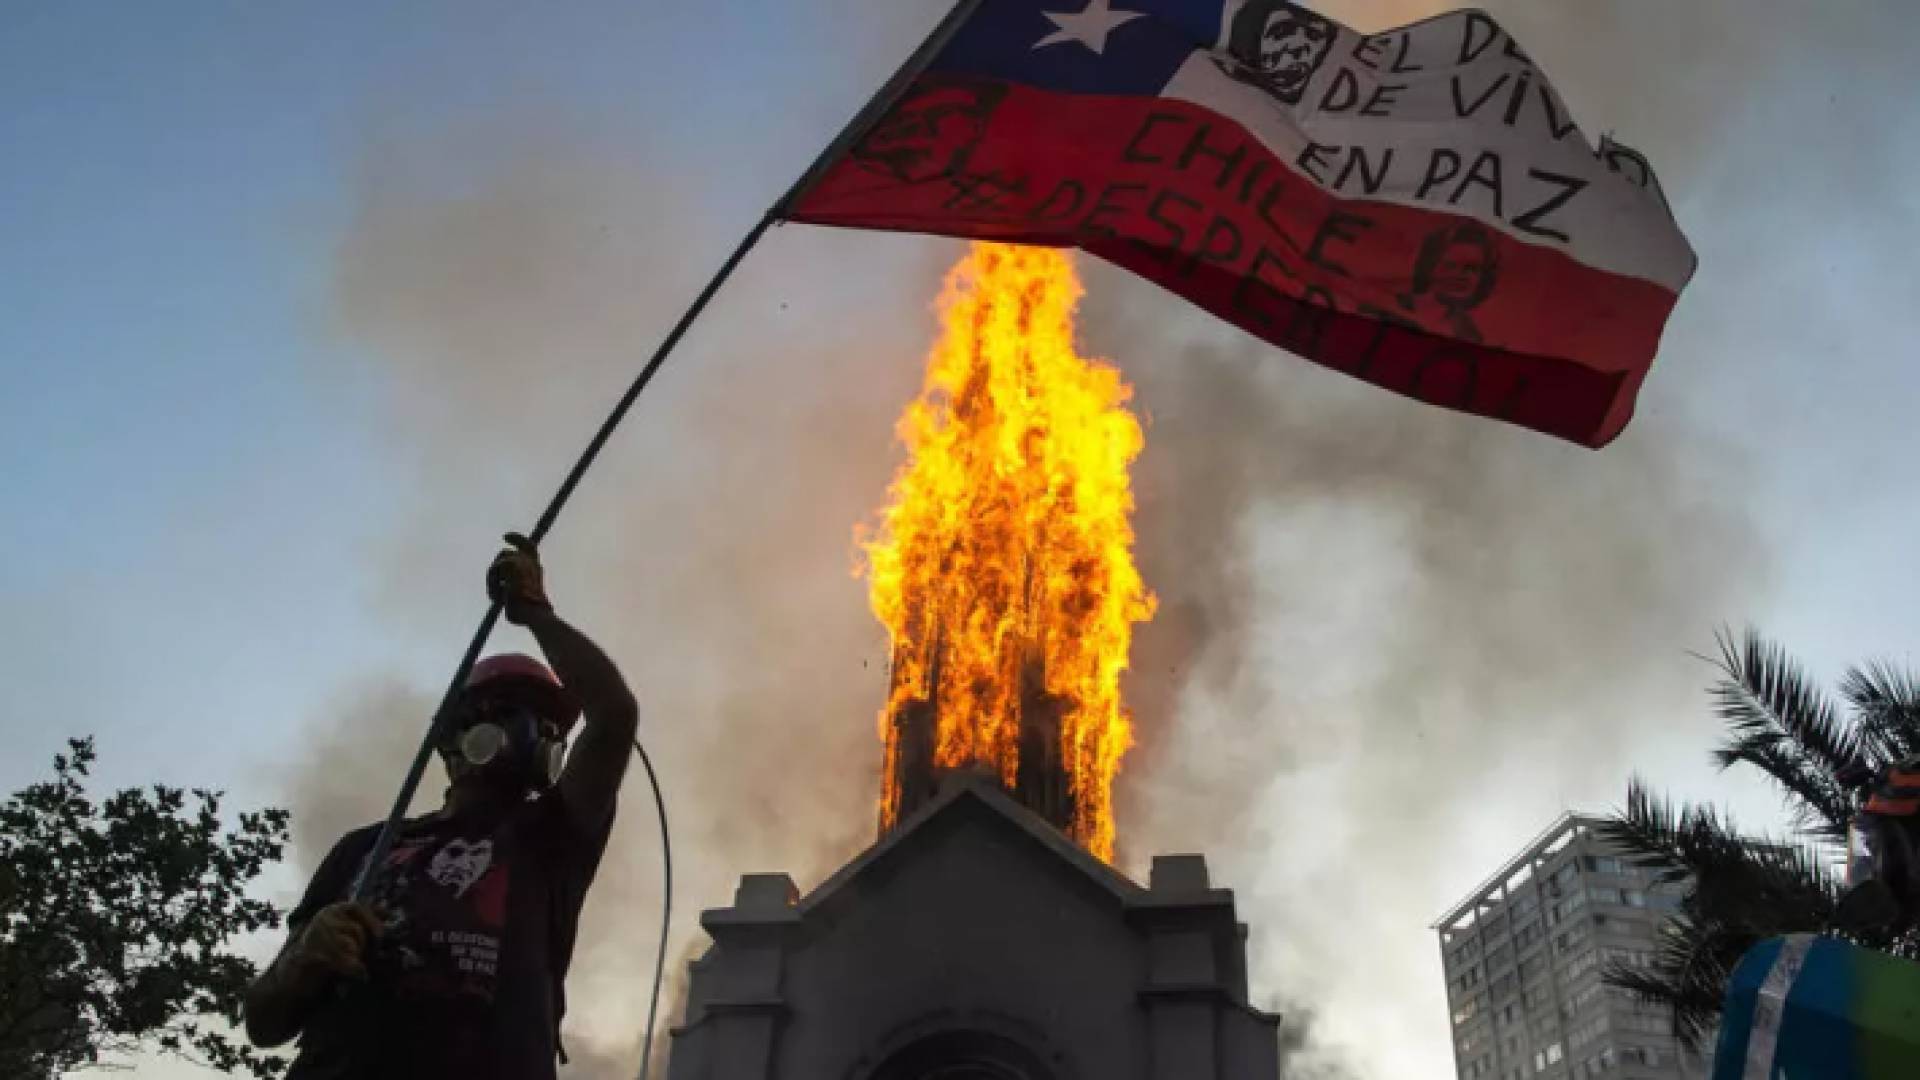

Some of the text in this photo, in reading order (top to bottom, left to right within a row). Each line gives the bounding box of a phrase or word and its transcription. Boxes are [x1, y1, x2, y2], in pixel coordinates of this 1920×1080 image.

[1352, 33, 1423, 73] EL
[1318, 67, 1407, 117] DE
[1123, 112, 1375, 277] CHILE
[1297, 142, 1590, 244] EN PAZ
